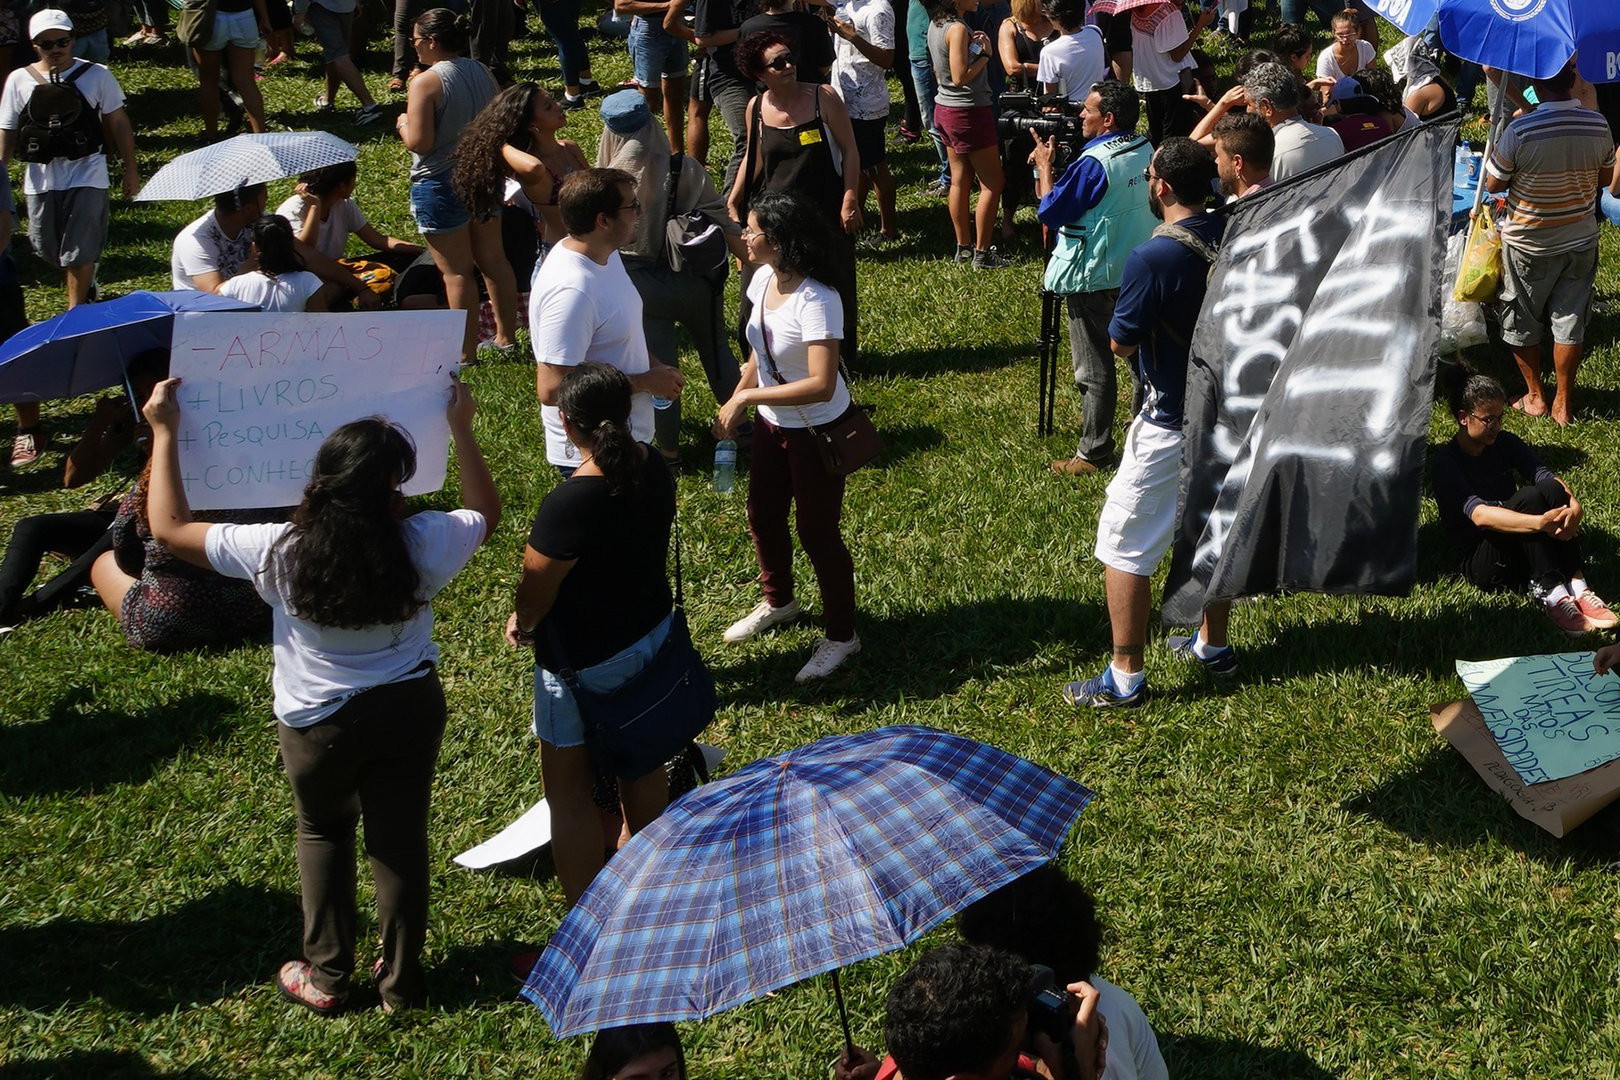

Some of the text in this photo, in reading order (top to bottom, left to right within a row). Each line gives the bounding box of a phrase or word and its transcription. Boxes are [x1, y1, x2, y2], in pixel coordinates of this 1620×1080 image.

[219, 325, 384, 371] ARMAS
[1264, 190, 1431, 475] ANTI
[1512, 708, 1538, 732] DAS
[1520, 694, 1566, 740] MÃOS
